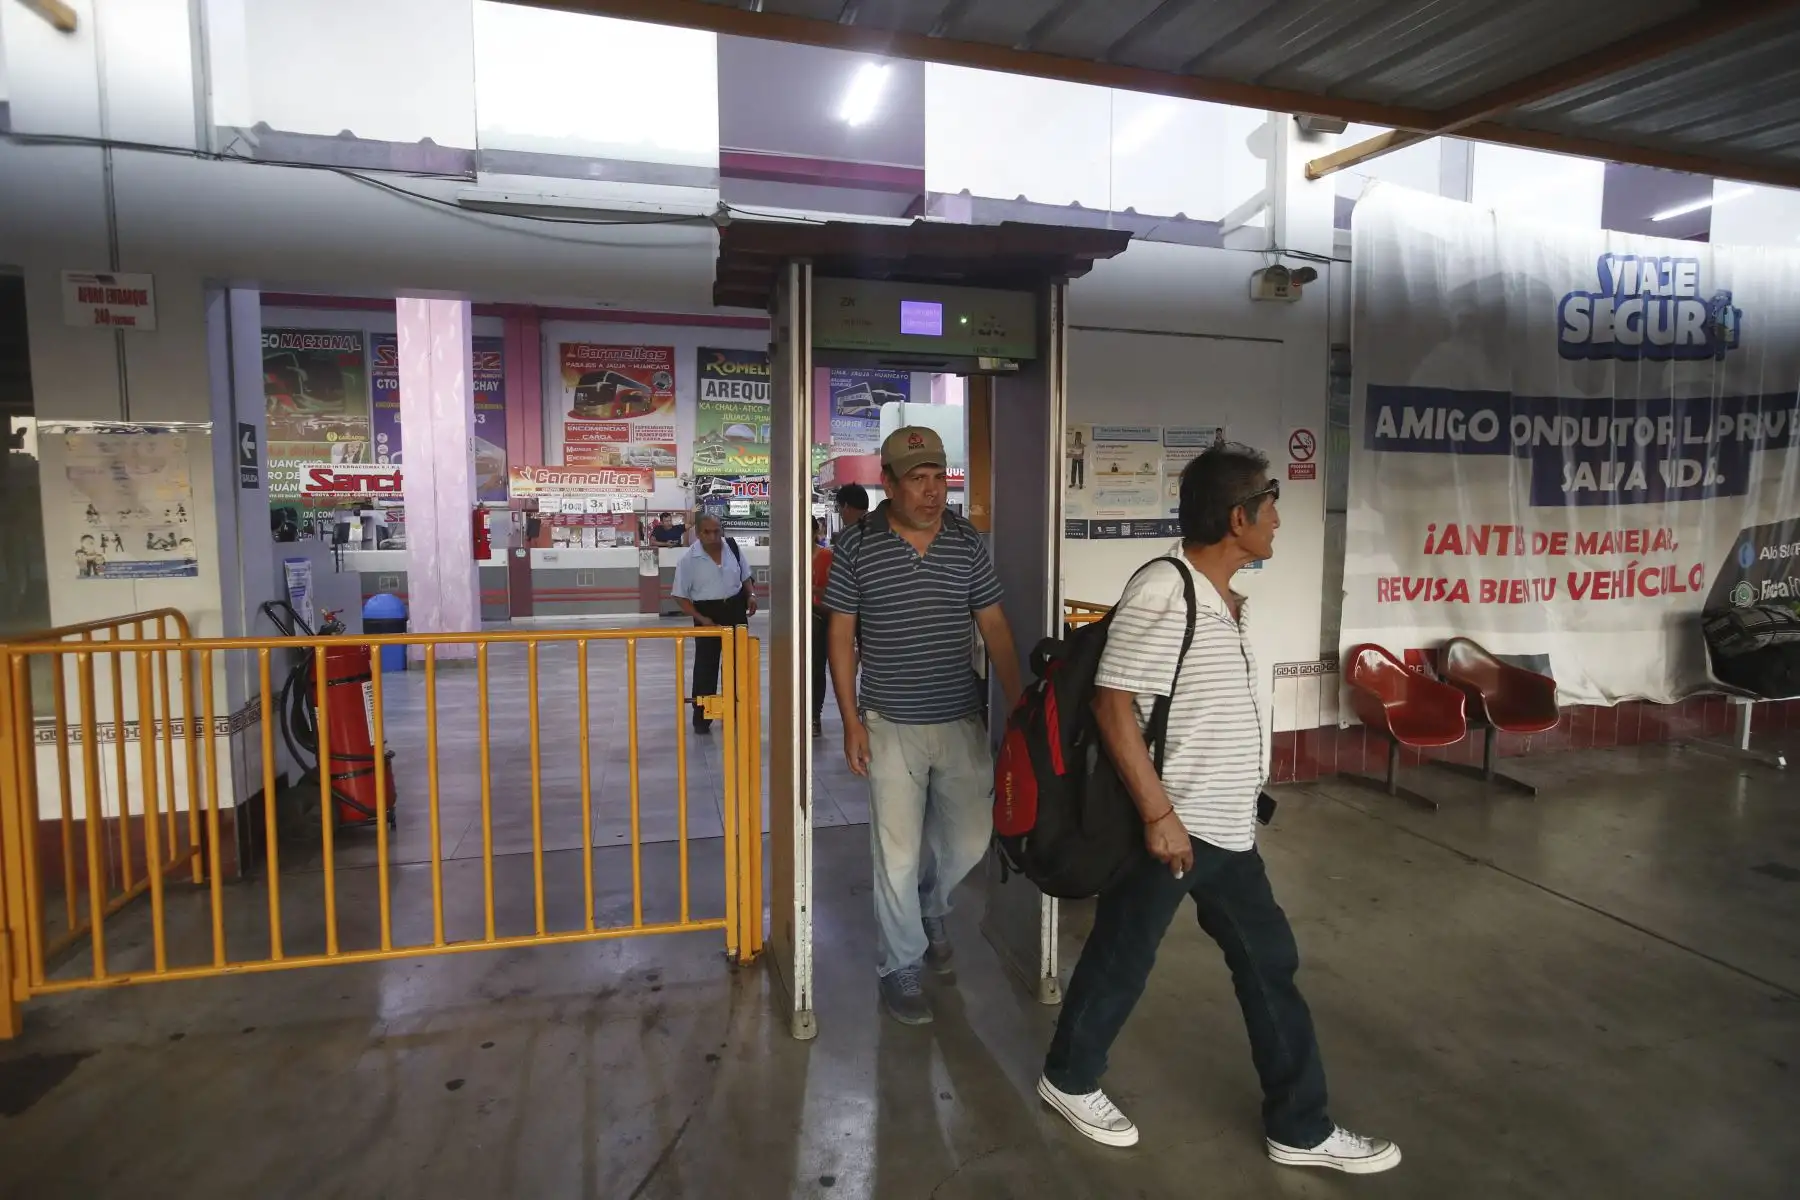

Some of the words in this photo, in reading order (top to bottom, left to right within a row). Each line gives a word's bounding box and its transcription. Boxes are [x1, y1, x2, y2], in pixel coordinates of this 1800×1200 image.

[1605, 257, 1696, 297] VIAJE
[281, 333, 363, 352] NACIONAL
[577, 345, 668, 362] Carmelitas
[373, 344, 399, 369] S
[1374, 404, 1500, 442] AMIGO
[535, 469, 641, 486] Carmelitas
[1532, 531, 1568, 556] DE
[1575, 528, 1679, 557] MANEJAR,
[1377, 577, 1470, 603] REVISA
[1479, 579, 1529, 603] BIEN
[1532, 578, 1556, 601] TU
